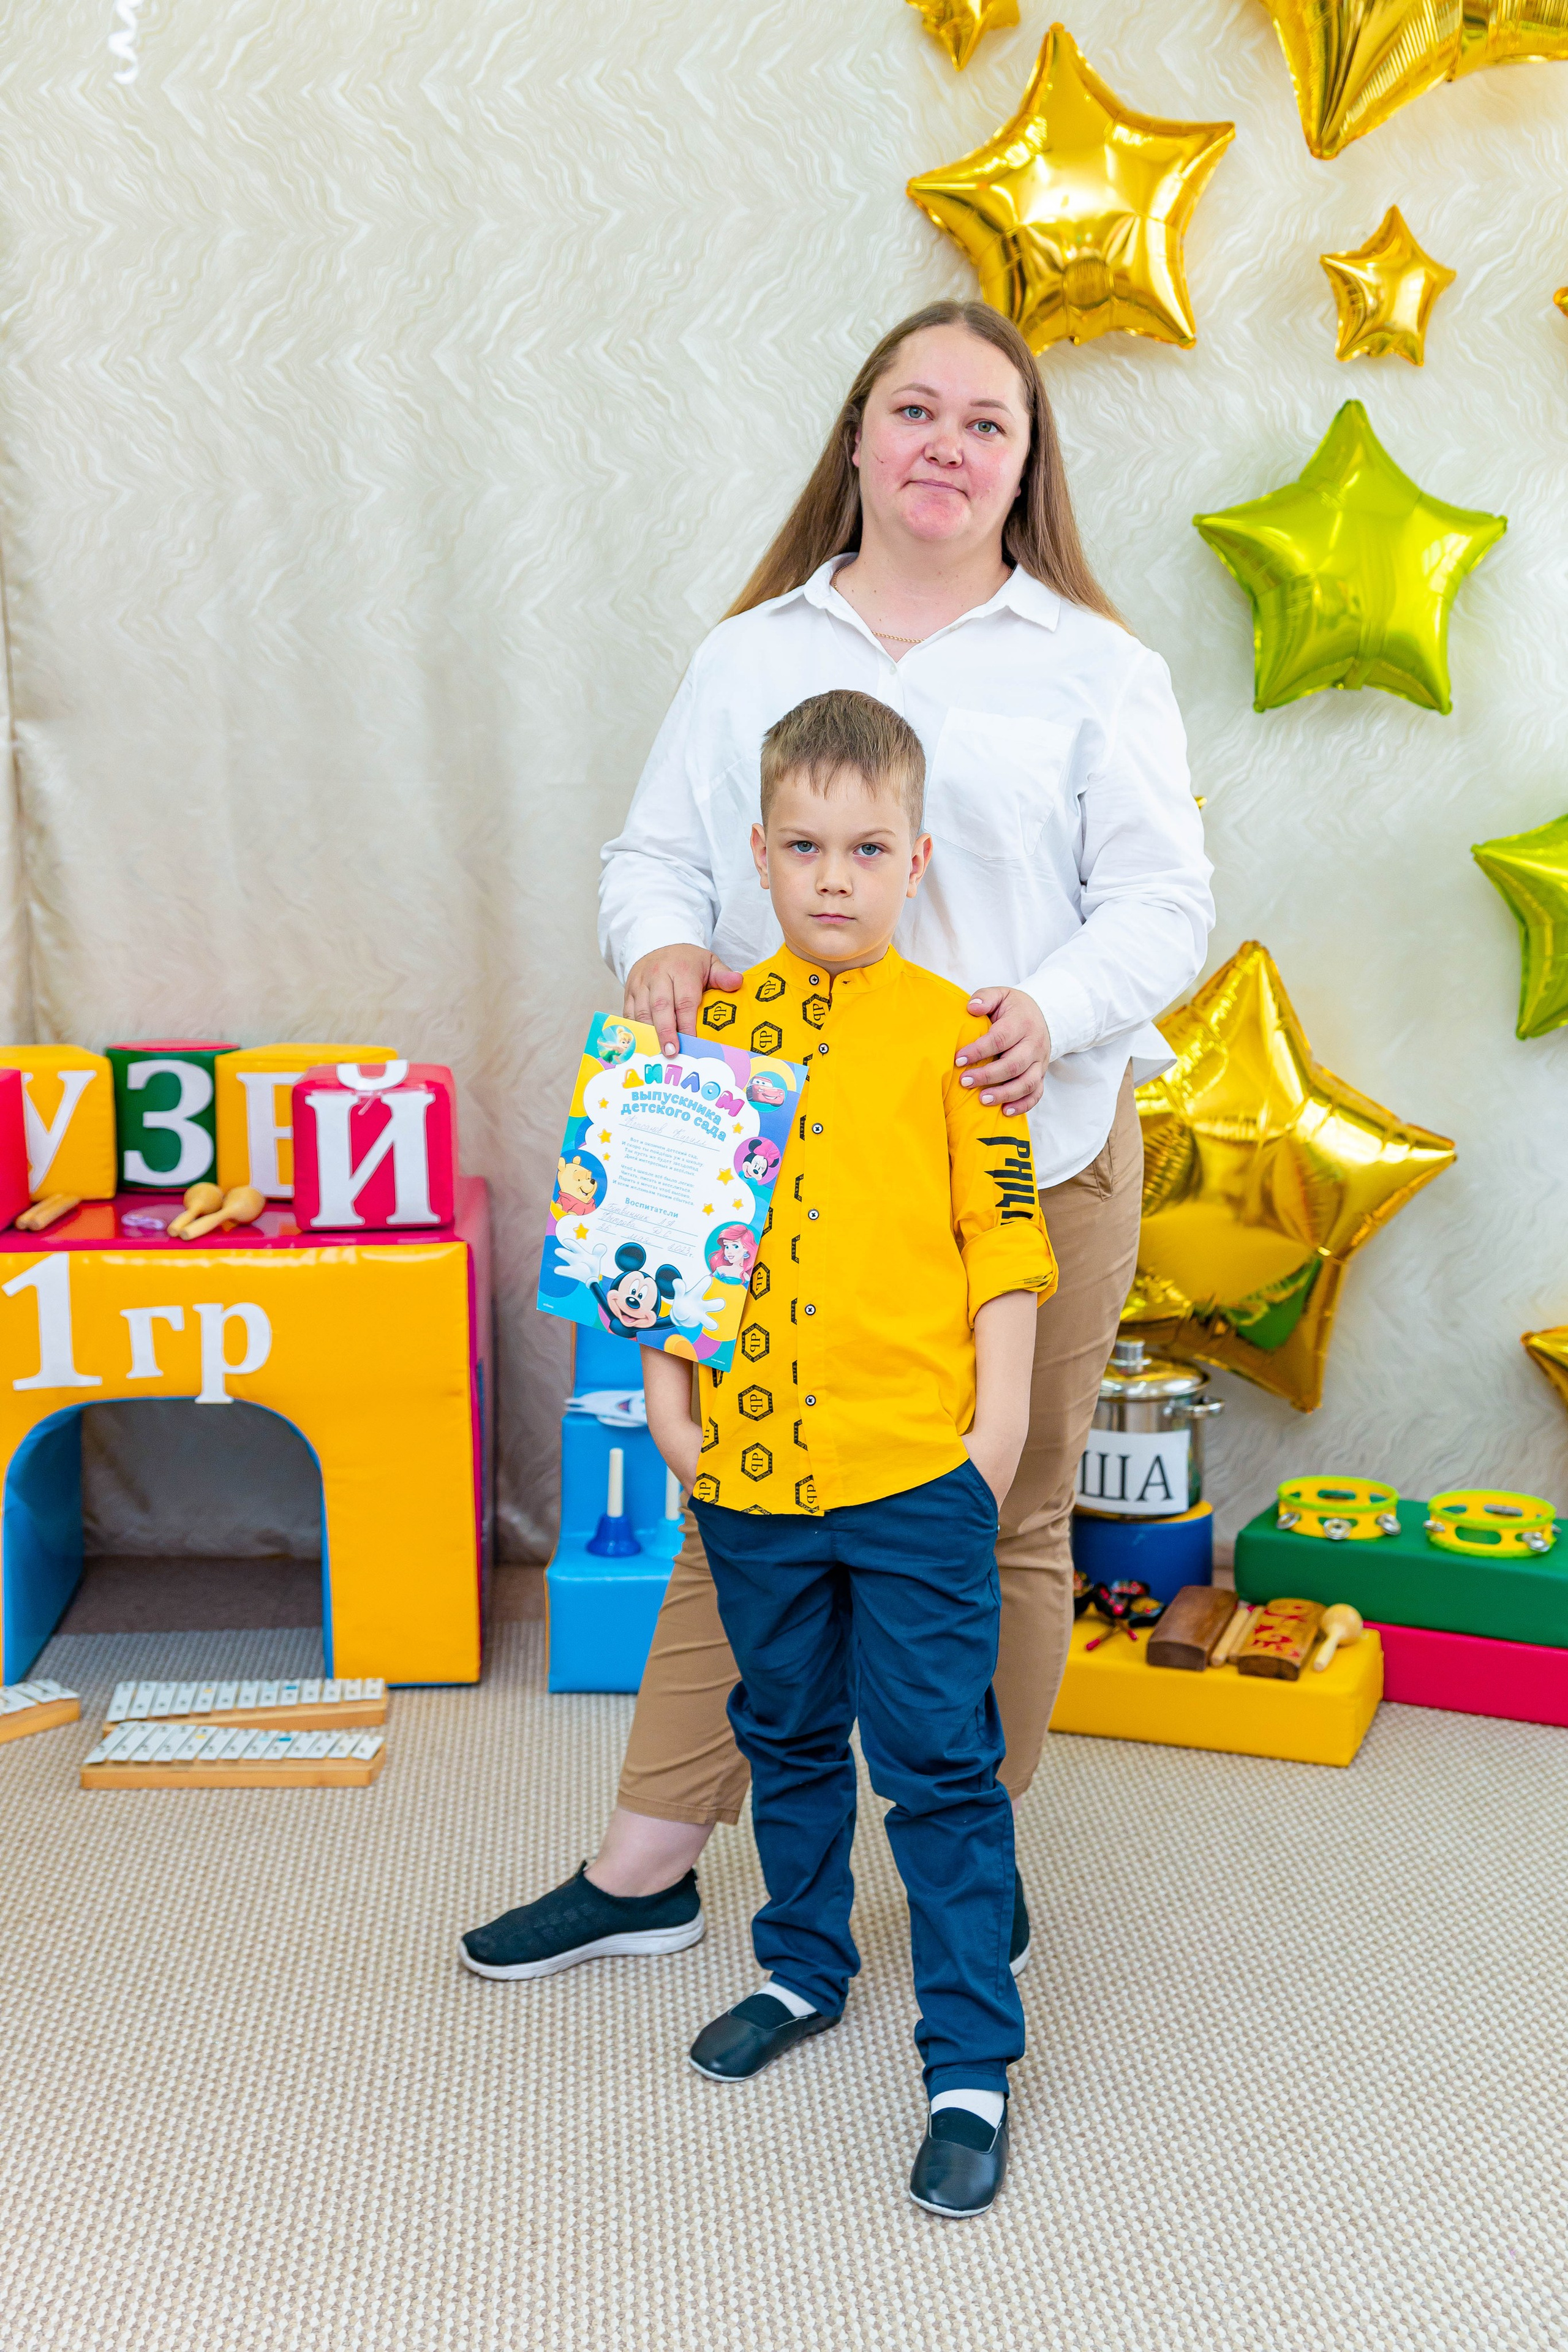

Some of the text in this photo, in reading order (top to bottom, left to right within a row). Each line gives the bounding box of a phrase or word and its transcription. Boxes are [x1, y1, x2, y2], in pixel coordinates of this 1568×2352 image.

[622, 1064, 745, 1117] ДИПЛОМ
[631, 1091, 722, 1125] выпускника
[620, 1102, 726, 1142] детского сада
[625, 1197, 679, 1218] Воспитатели
[2, 1253, 272, 1404] 1 гр
